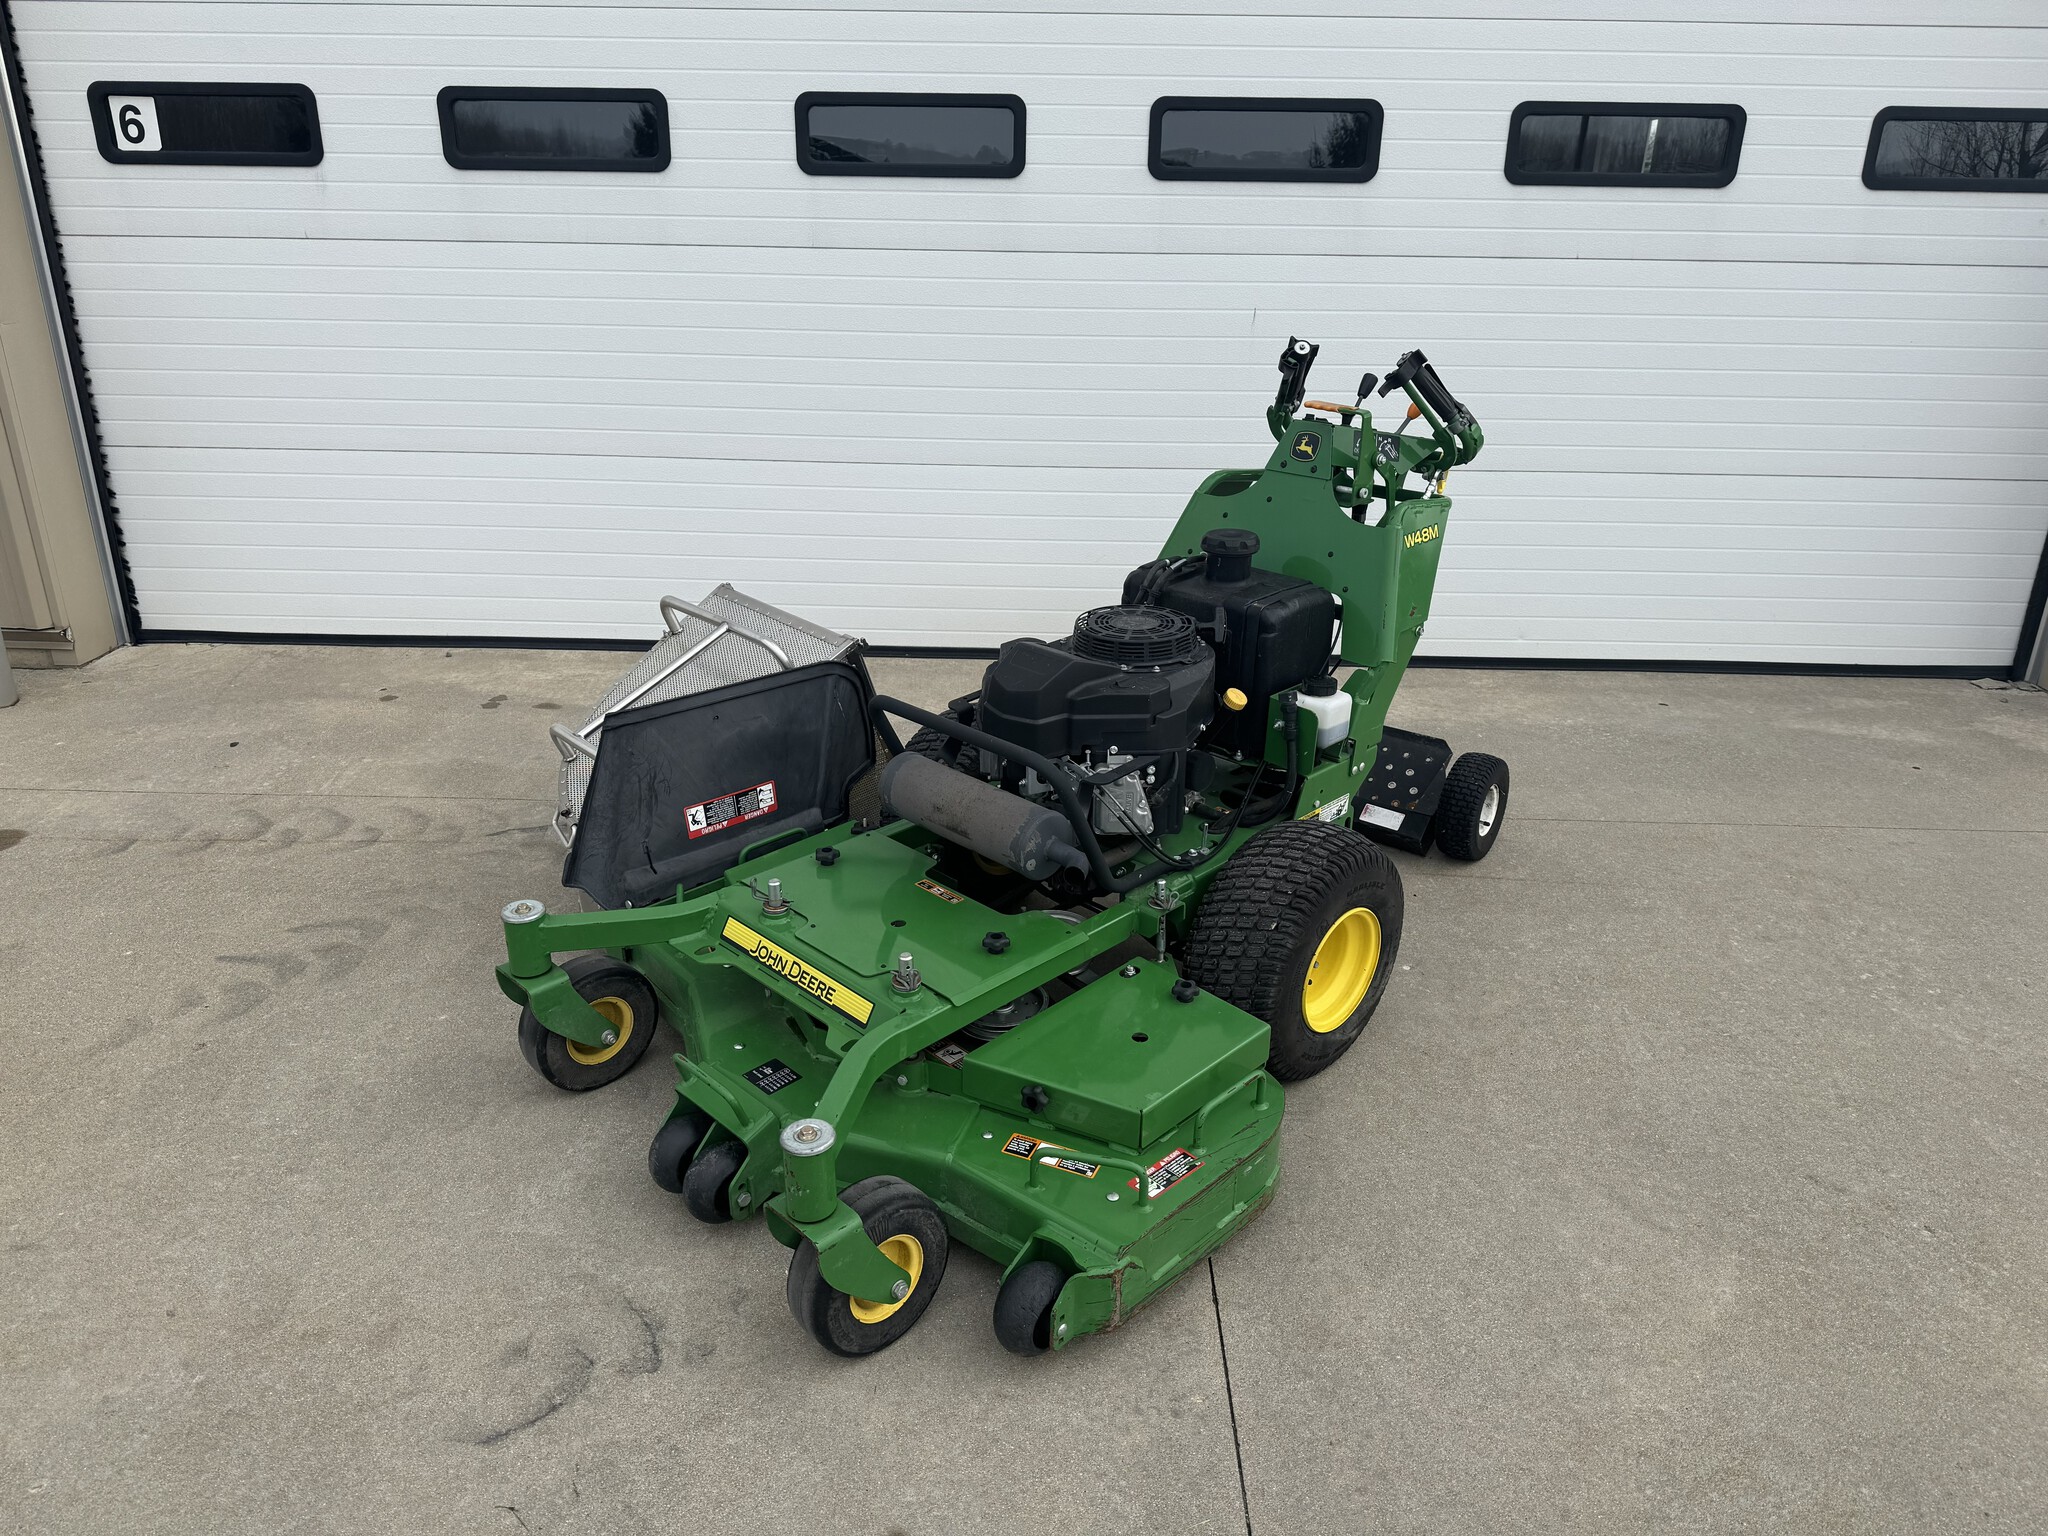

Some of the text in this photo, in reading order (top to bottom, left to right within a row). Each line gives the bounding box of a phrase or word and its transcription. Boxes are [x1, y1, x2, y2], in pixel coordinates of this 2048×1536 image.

[119, 104, 145, 144] 6
[1403, 524, 1439, 549] W48M
[749, 939, 837, 1003] JOHN DEERE
